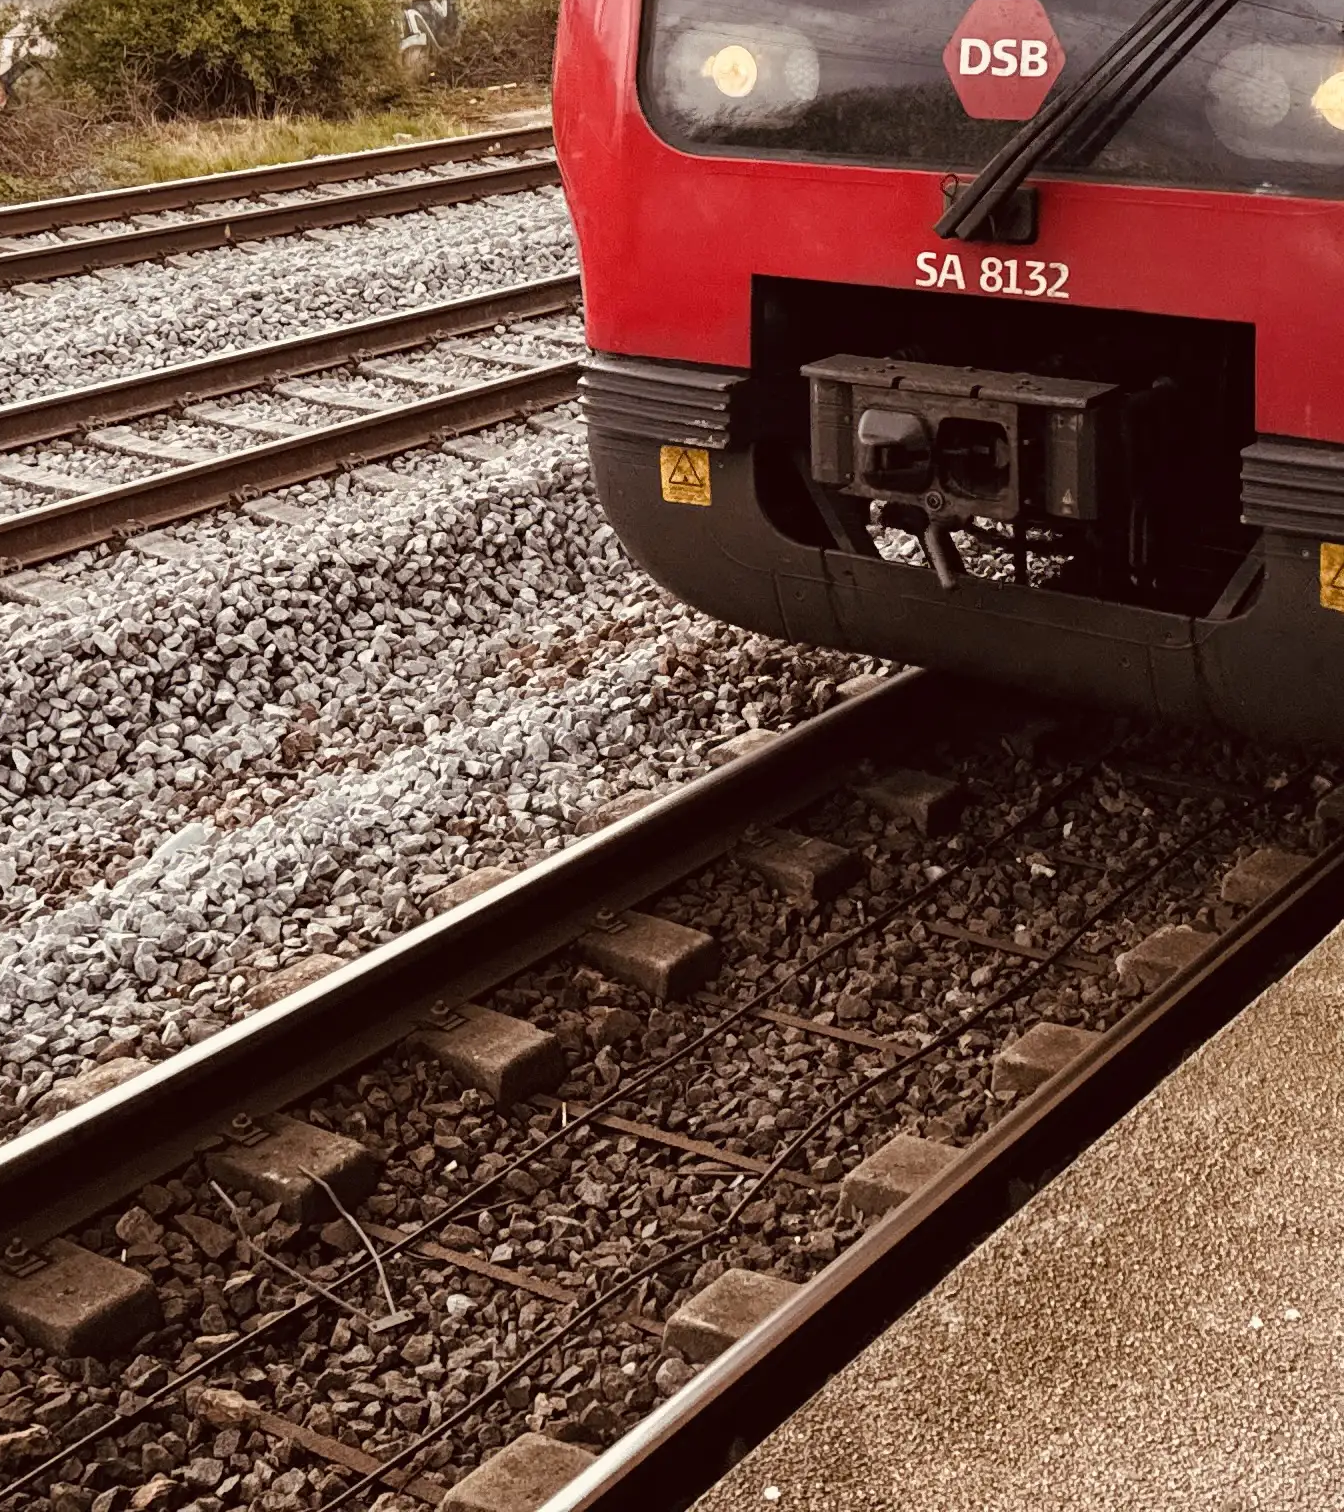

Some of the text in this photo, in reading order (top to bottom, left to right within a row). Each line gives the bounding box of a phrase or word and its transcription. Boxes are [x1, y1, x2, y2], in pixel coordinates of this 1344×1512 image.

[958, 37, 1049, 78] DSB
[915, 251, 1071, 299] SA 8132
